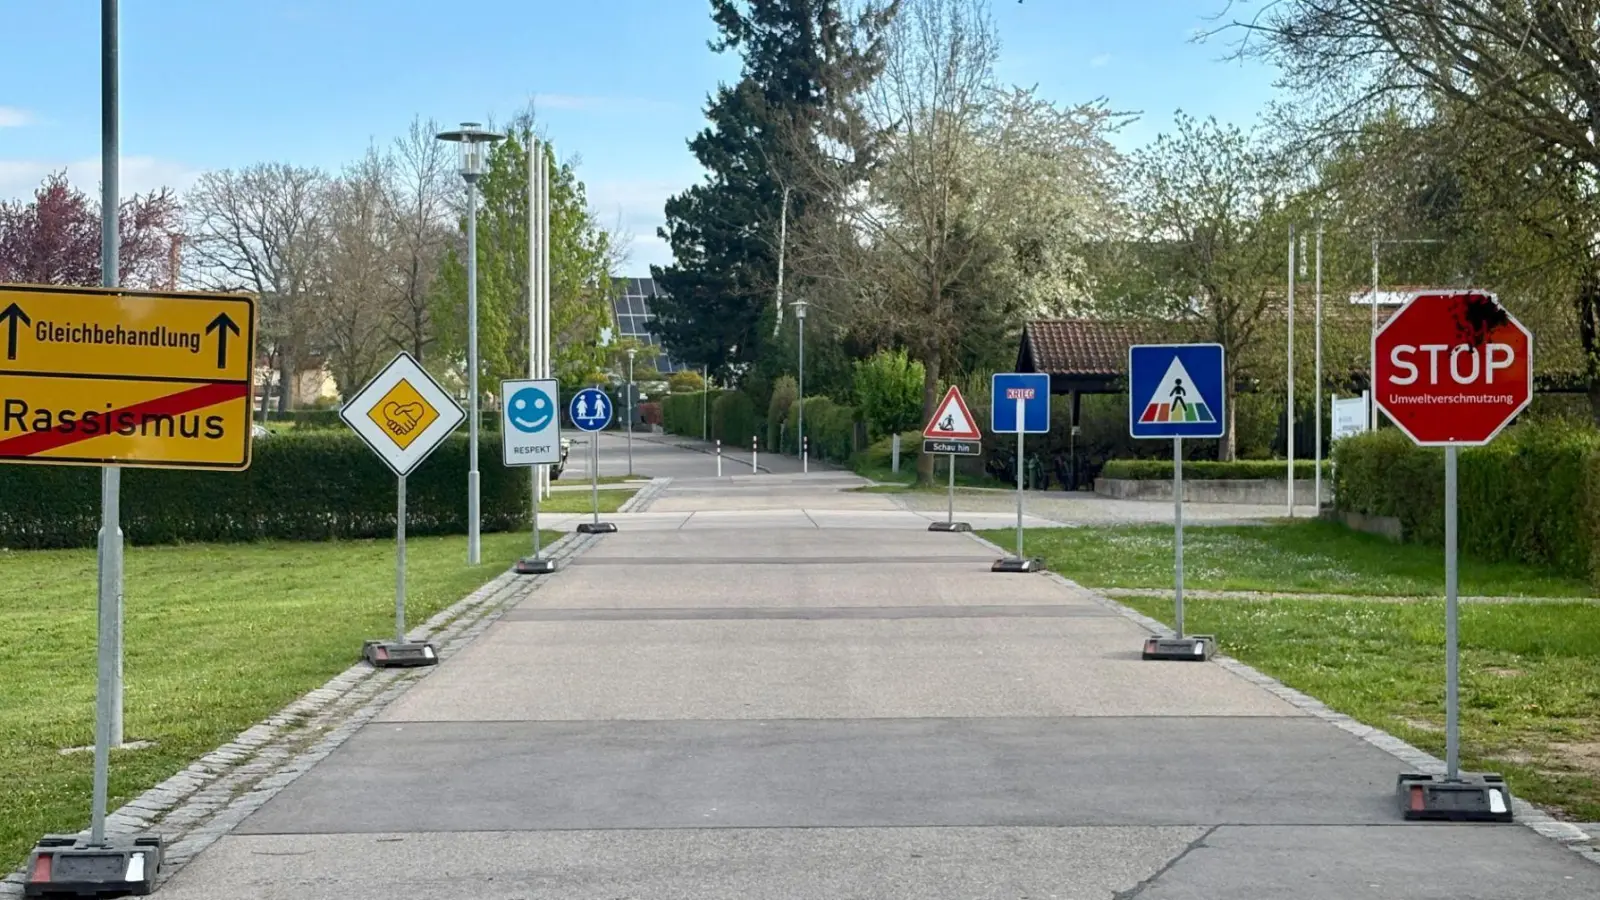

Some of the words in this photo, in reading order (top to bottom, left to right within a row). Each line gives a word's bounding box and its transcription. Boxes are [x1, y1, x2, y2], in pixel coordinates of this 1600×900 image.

[36, 321, 201, 353] Gleichbehandlung
[1388, 343, 1515, 385] STOP
[1007, 388, 1034, 399] KRIEG
[1389, 393, 1514, 405] Umweltverschmutzung
[3, 398, 225, 439] Rassismus
[513, 445, 551, 454] RESPEKT
[933, 443, 956, 452] Schau
[957, 444, 970, 453] hin
